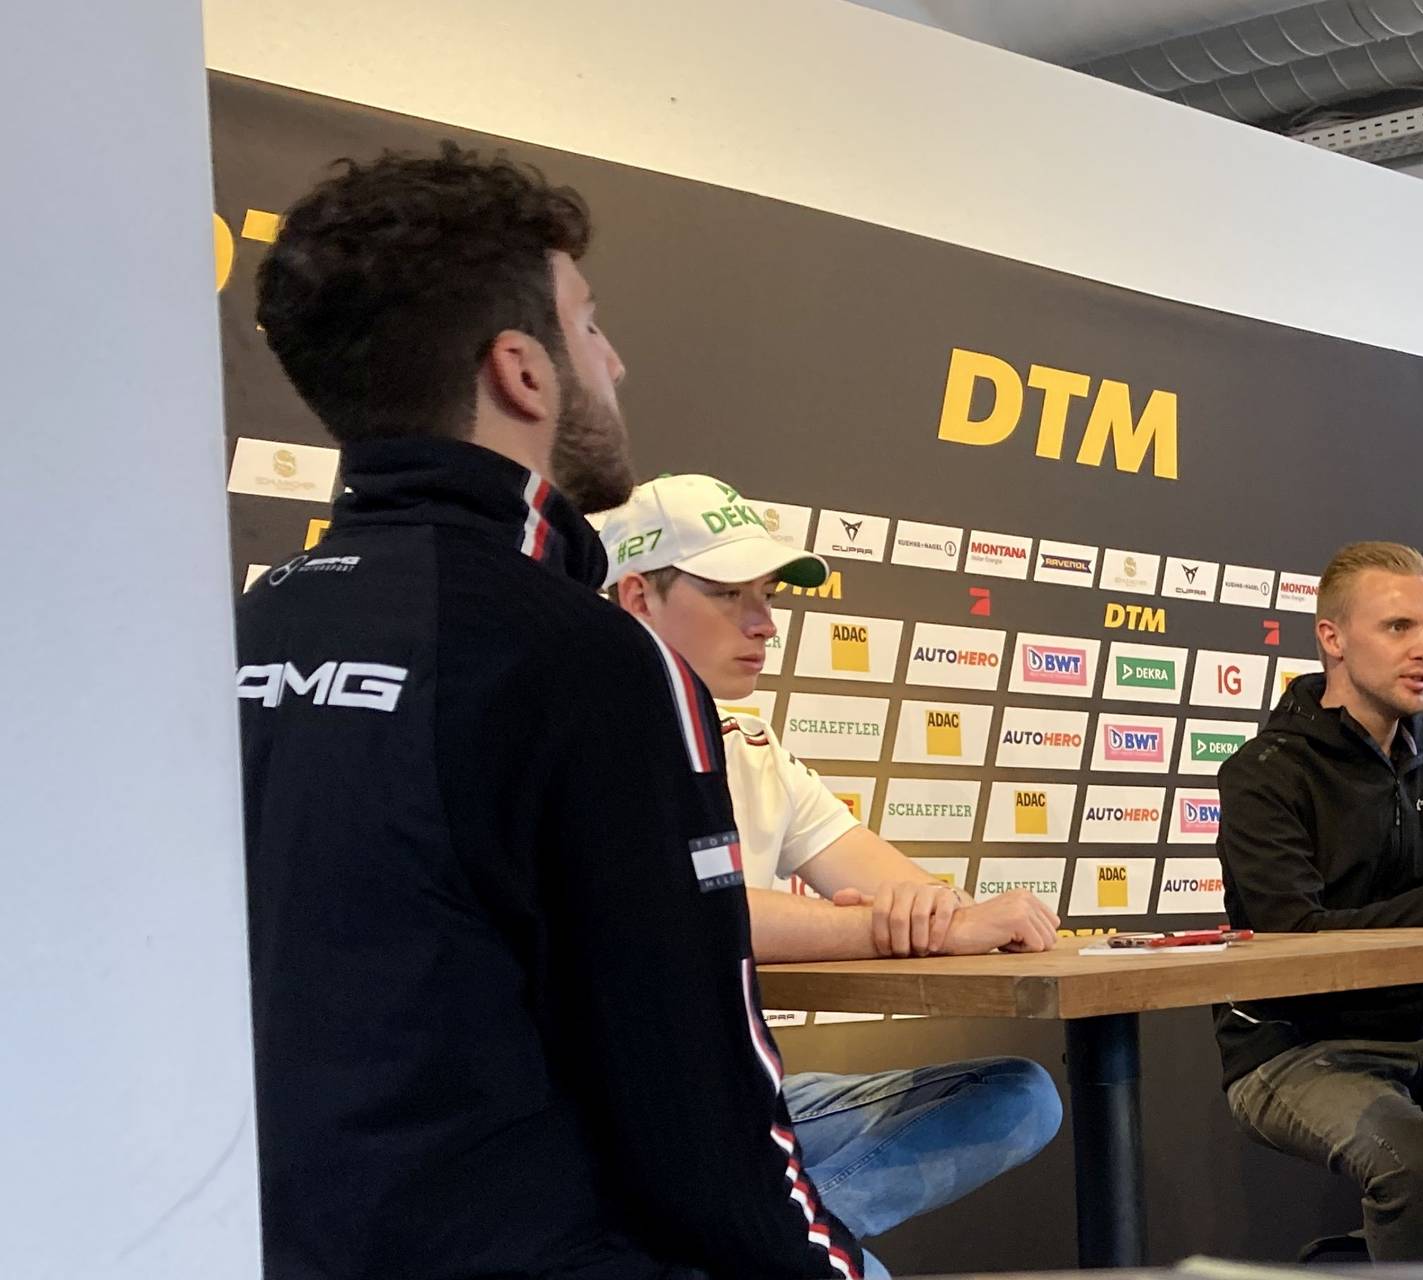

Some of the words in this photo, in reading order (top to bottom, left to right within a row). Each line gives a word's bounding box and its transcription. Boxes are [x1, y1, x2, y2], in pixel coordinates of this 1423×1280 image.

[938, 348, 1178, 480] DTM
[701, 505, 766, 533] DEK
[617, 528, 663, 564] #27
[832, 545, 872, 555] CUPRA
[971, 542, 1026, 559] MONTANA
[1045, 557, 1088, 571] RAVENOL
[1280, 582, 1319, 596] MONTAN
[1104, 603, 1166, 634] DTM
[832, 624, 867, 643] ADAC
[913, 647, 999, 667] AUTOHERO
[1045, 654, 1080, 673] BWT
[1136, 667, 1168, 681] DEKRA
[1217, 664, 1242, 695] IG
[236, 662, 408, 712] AMG
[789, 718, 881, 737] SCHAEFFLER
[927, 711, 960, 729] ADAC
[1003, 730, 1082, 748] AUTOHERO
[1125, 733, 1158, 751] BWT
[1209, 741, 1239, 754] DEKRA
[1016, 792, 1046, 808] ADAC
[888, 803, 972, 818] SCHAEFFLER
[1086, 807, 1160, 822] AUTOHERO
[1199, 806, 1222, 822] BW
[1098, 867, 1127, 881] ADAC
[1164, 879, 1225, 893] AUTOHER
